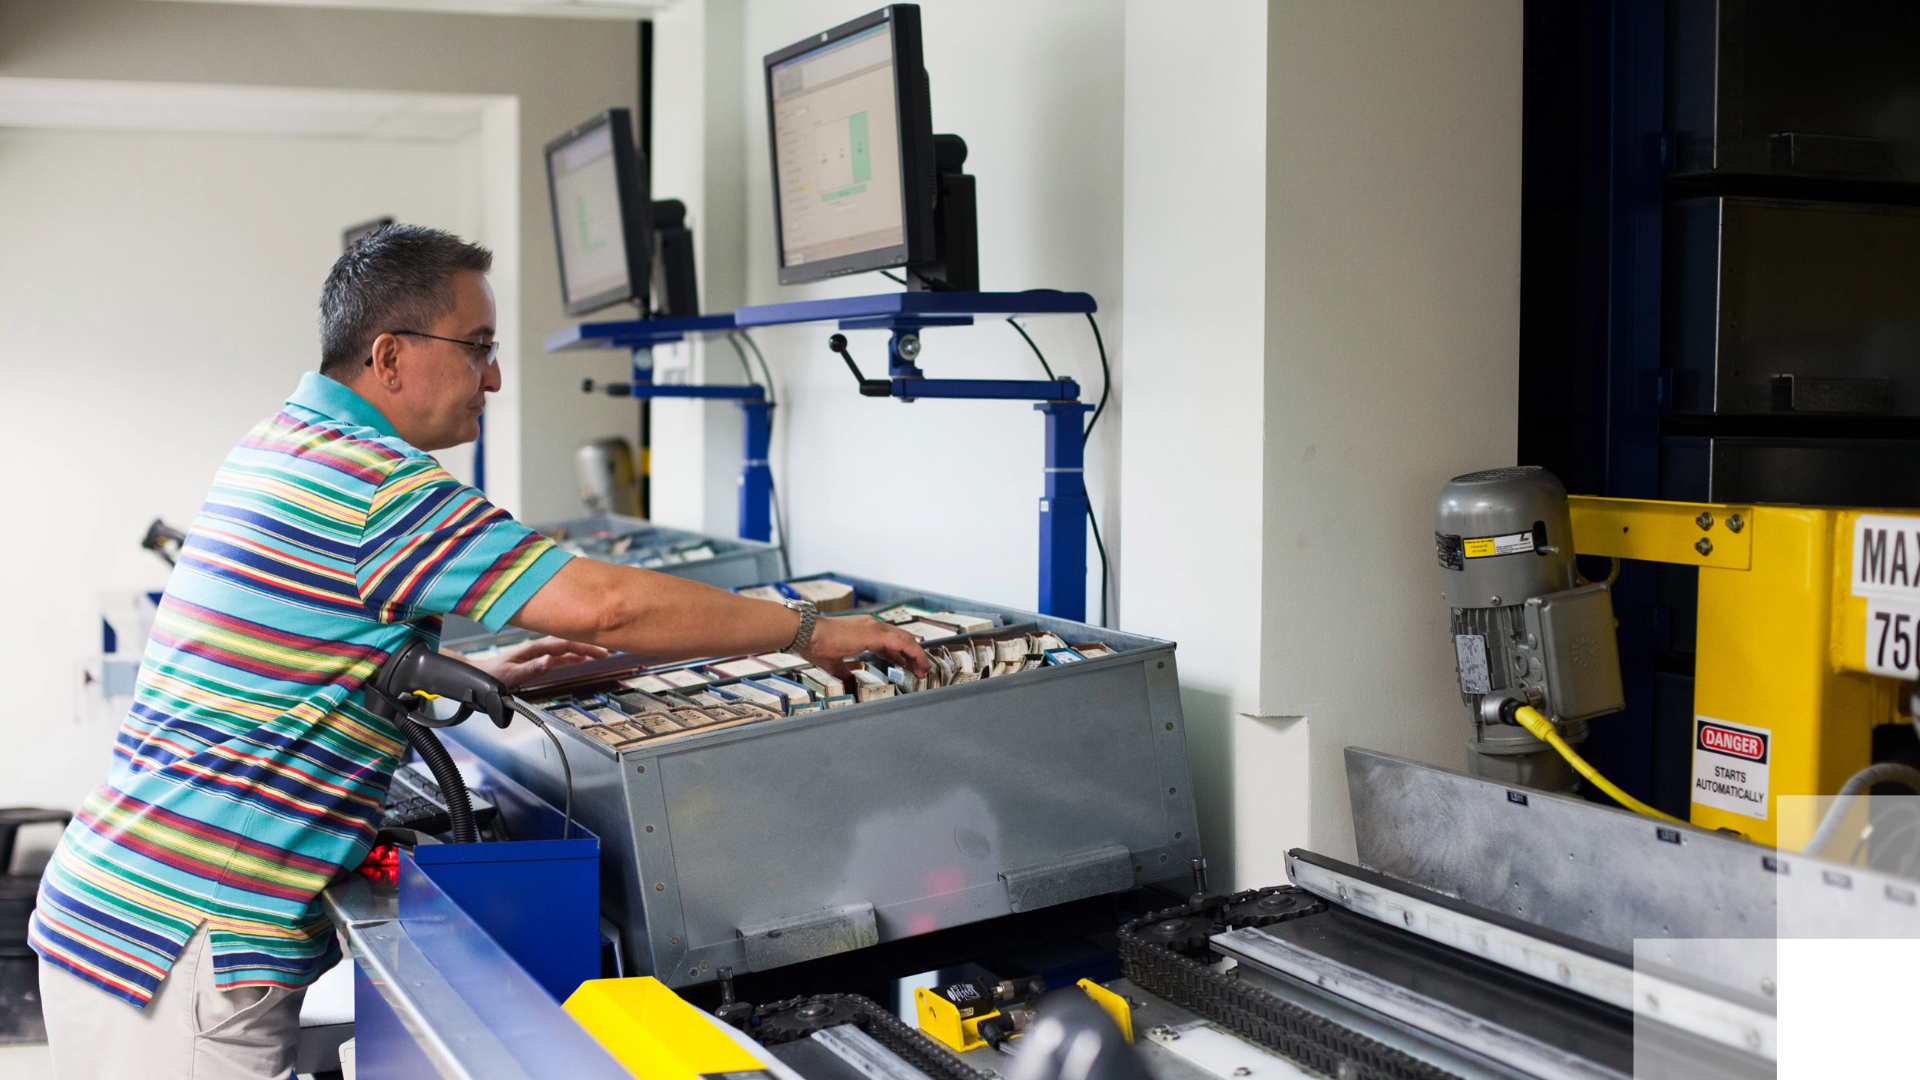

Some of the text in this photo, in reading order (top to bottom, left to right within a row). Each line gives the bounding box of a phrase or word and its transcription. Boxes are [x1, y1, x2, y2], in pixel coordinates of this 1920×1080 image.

[1875, 611, 1920, 671] 75
[1706, 729, 1758, 755] DANGER
[1714, 765, 1747, 783] STARTS
[1695, 777, 1765, 804] AUTOMATICALLY
